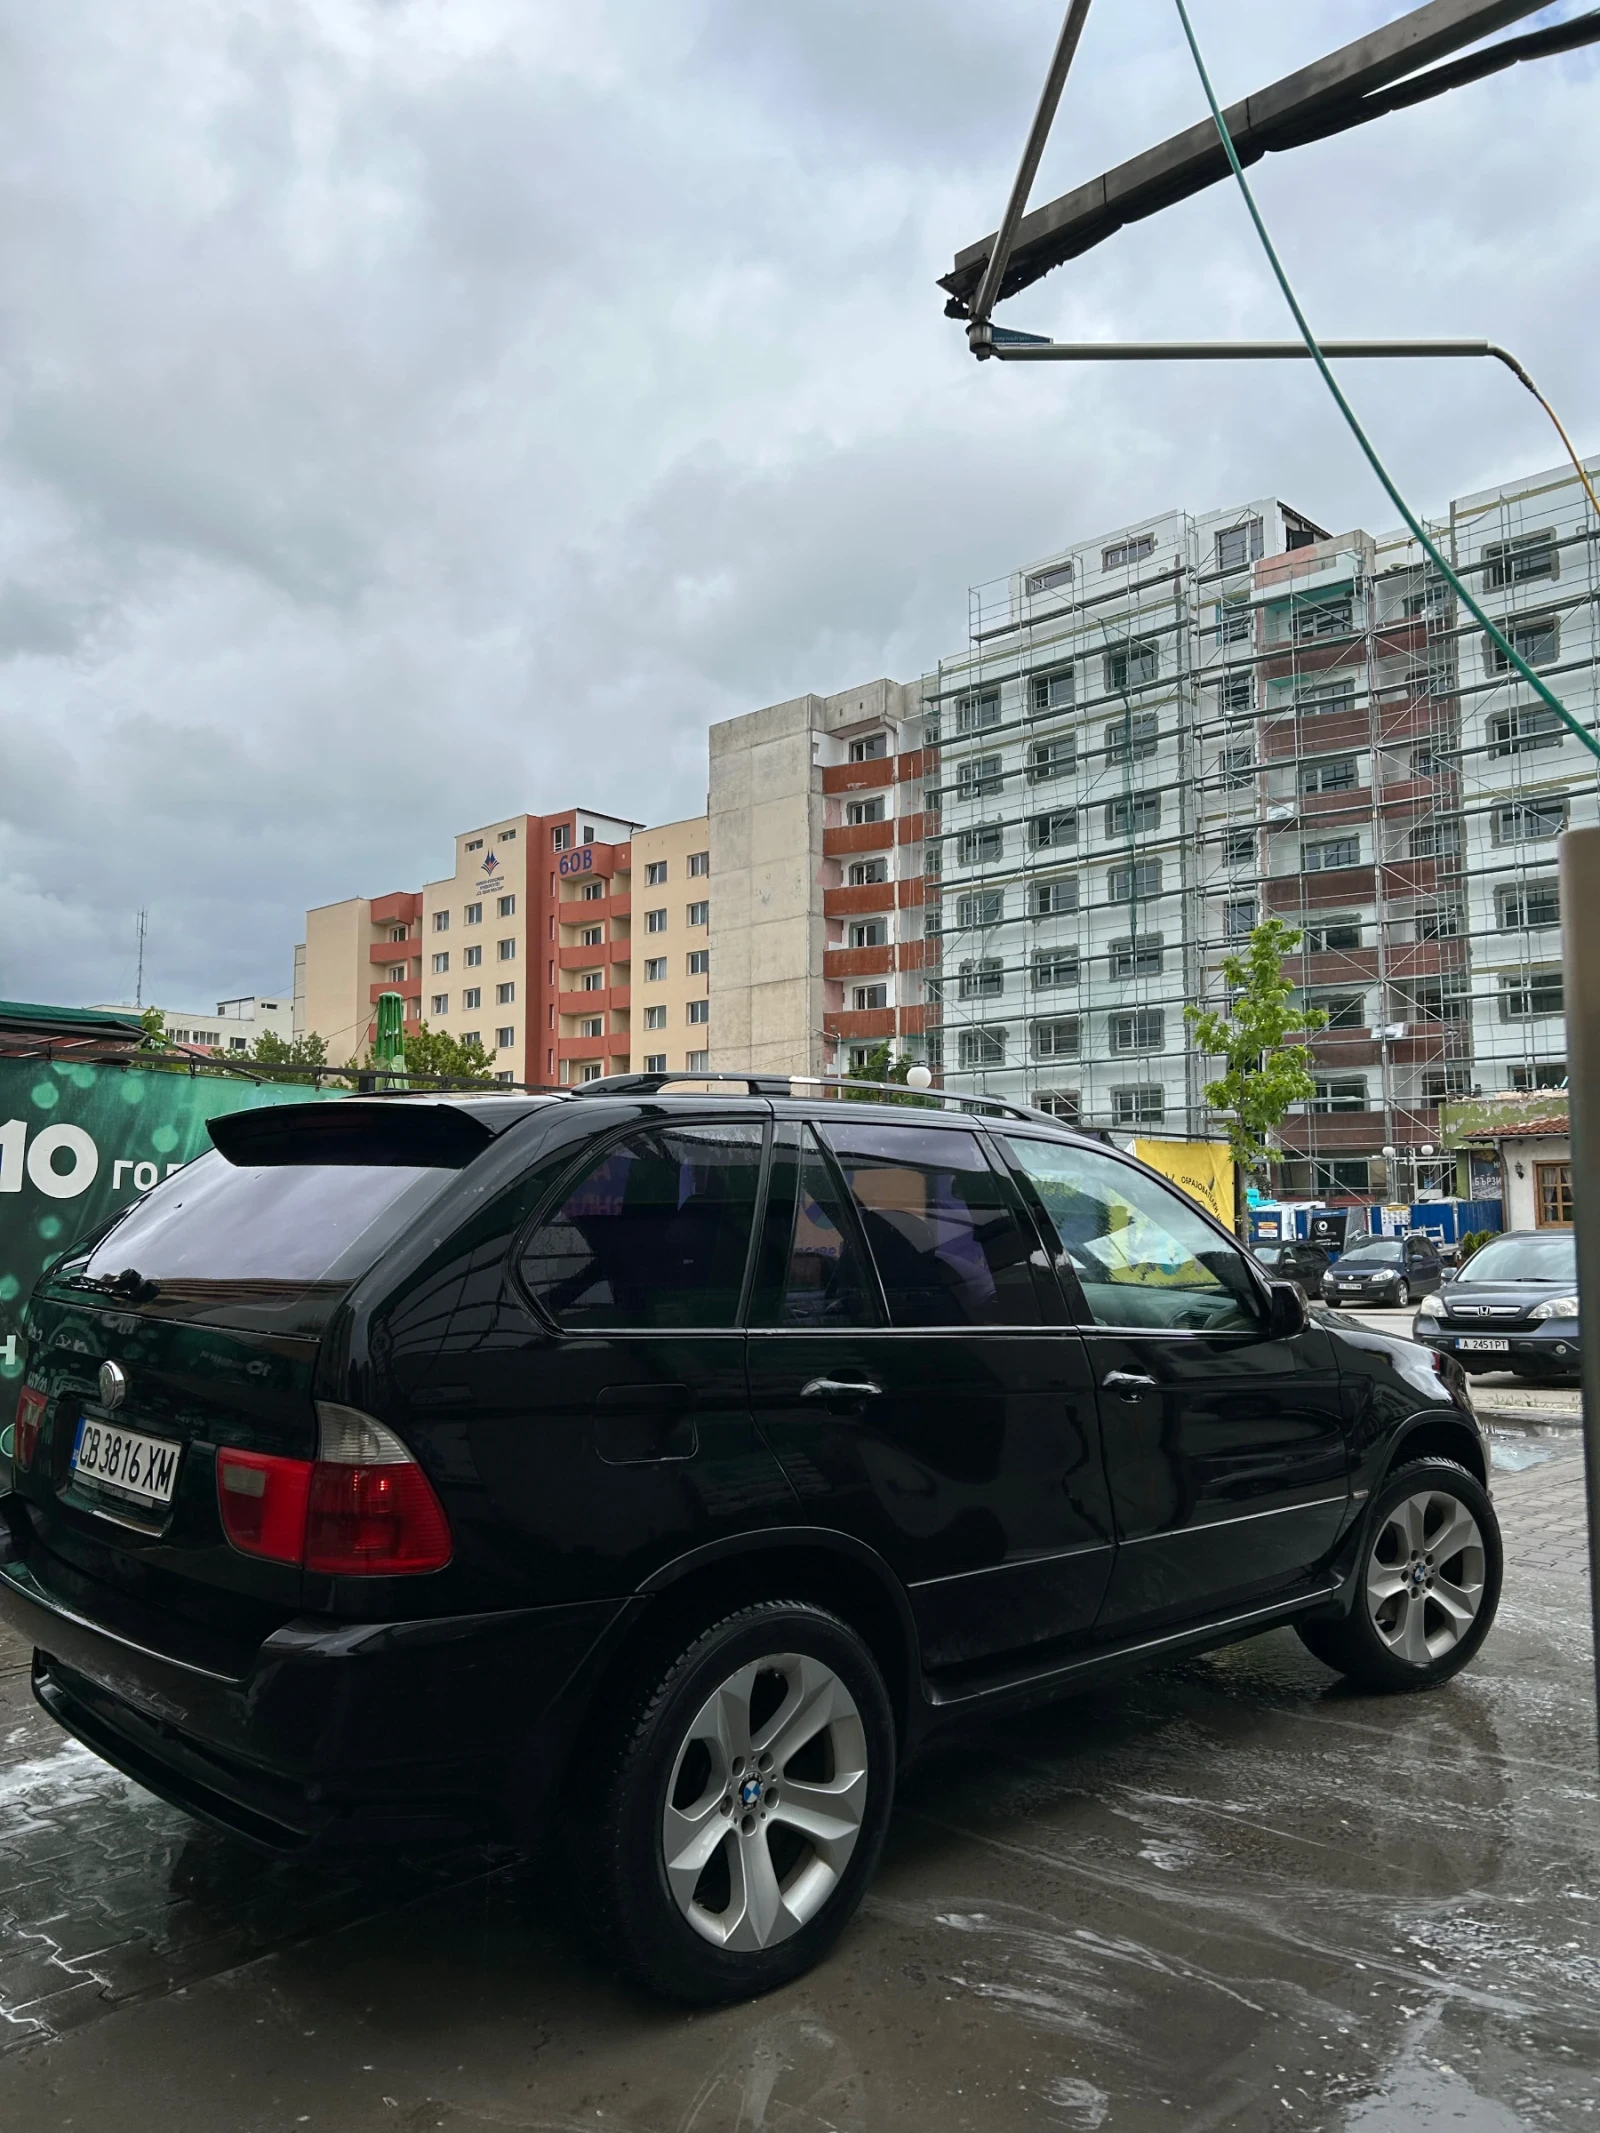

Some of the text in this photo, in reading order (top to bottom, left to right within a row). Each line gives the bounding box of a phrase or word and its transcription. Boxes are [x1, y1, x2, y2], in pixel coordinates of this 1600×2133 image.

[0, 1119, 98, 1198] 10
[1463, 1340, 1469, 1349] A
[1472, 1340, 1494, 1349] 2451
[80, 1426, 101, 1469] CB
[141, 1445, 176, 1494] XM
